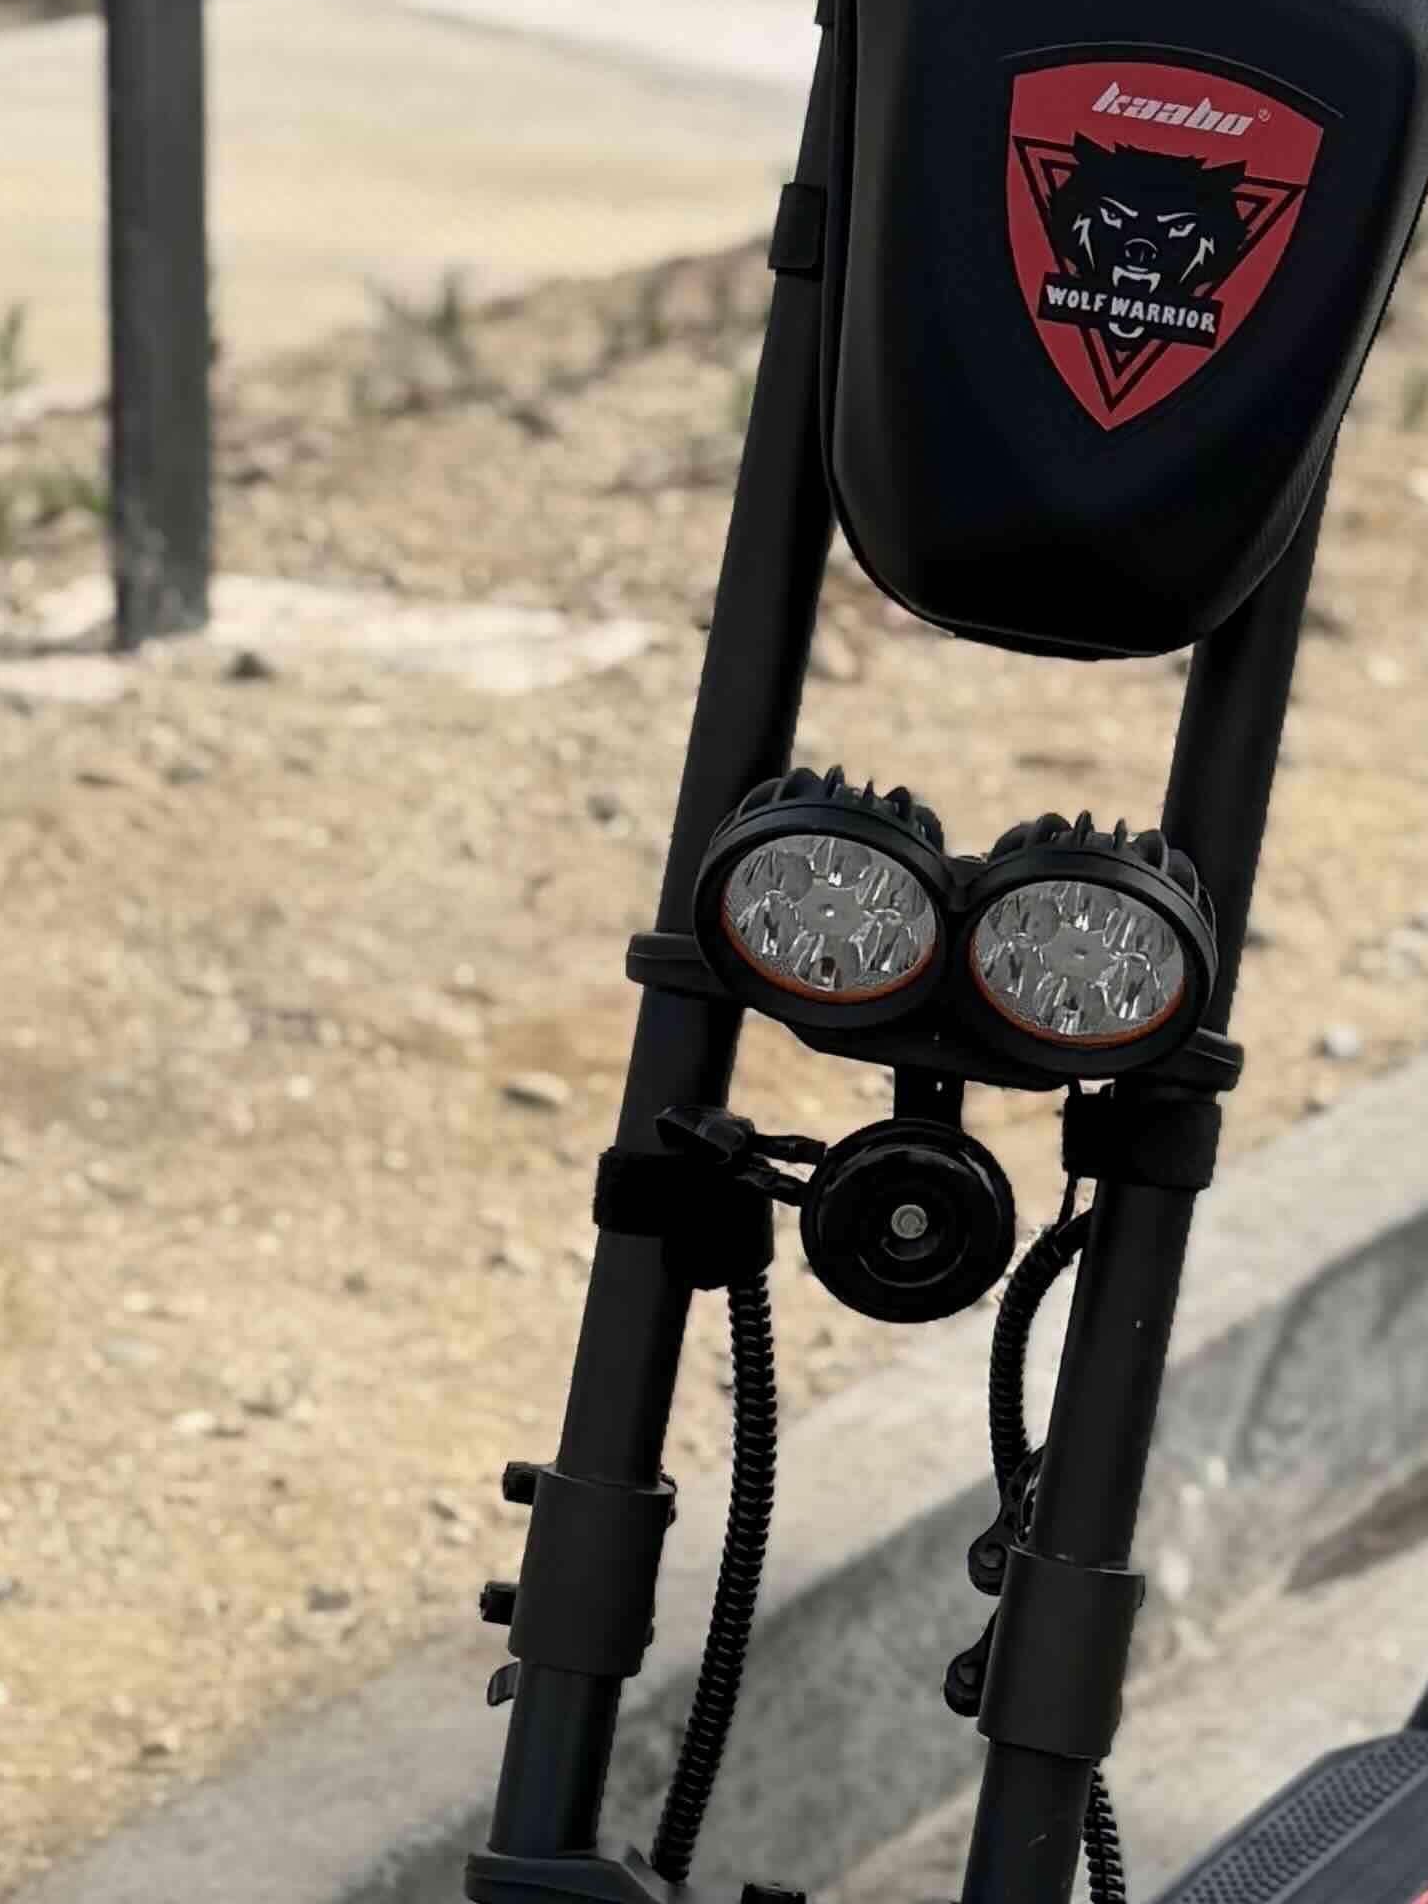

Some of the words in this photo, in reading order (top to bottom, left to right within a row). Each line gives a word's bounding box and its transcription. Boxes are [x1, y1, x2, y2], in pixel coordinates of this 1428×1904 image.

[1091, 80, 1254, 137] kaabo
[1045, 283, 1108, 313] WOLF
[1109, 295, 1216, 334] WARRIOR
